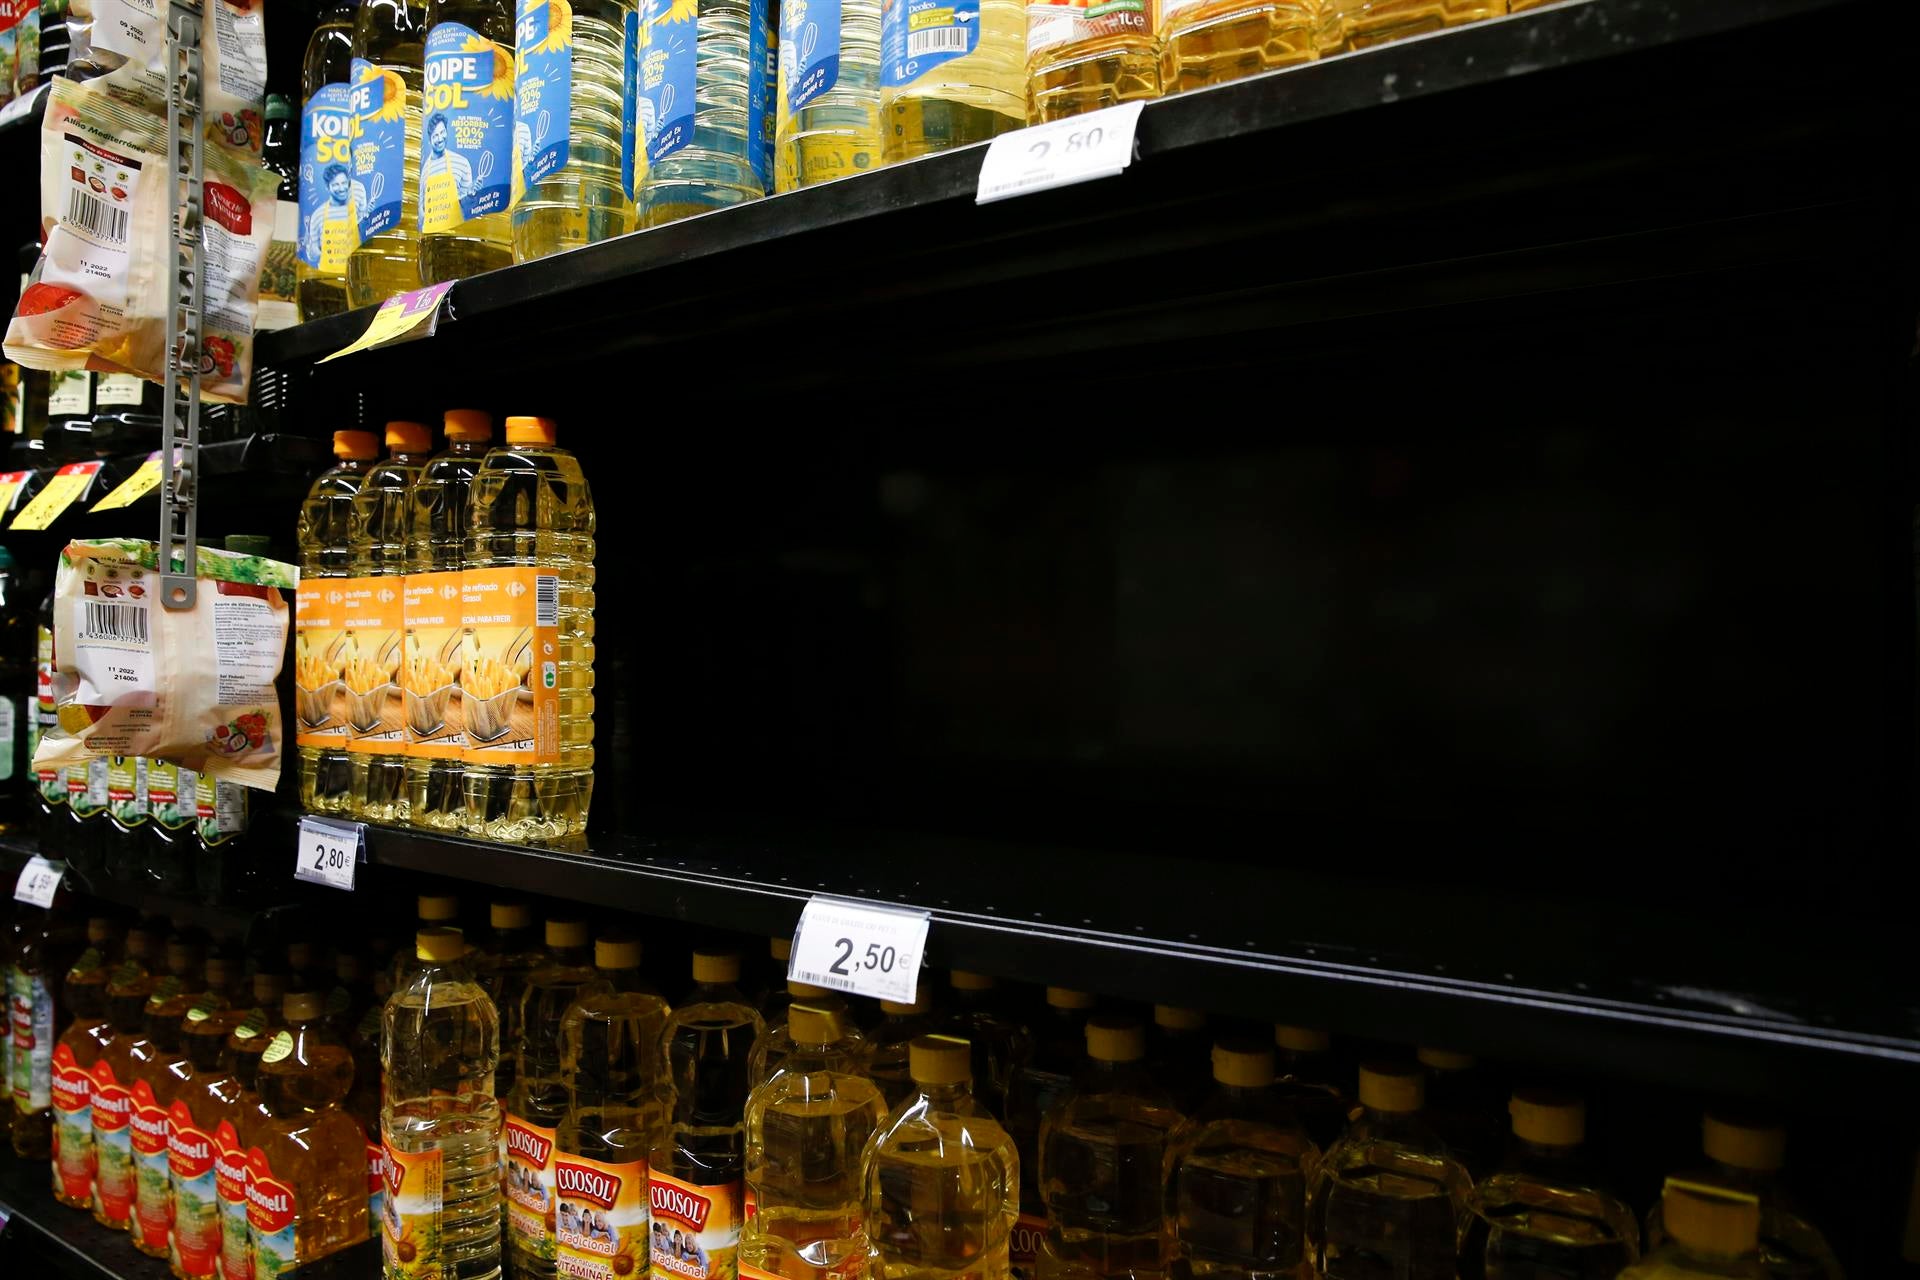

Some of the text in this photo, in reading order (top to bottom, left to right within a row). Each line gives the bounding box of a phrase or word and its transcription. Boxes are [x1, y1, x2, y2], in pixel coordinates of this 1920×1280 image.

[425, 82, 468, 115] SOL
[452, 120, 488, 129] ABSORBEN
[455, 127, 484, 139] 20%
[88, 126, 146, 154] Mediterráneo
[85, 268, 111, 279] 214005
[90, 263, 108, 272] 2022
[89, 632, 117, 641] 436006
[114, 674, 139, 682] 214005
[119, 667, 135, 675] 2022
[91, 1093, 130, 1112] rbonell
[130, 1112, 168, 1135] rbonell
[168, 1134, 208, 1159] rbonell
[558, 1168, 612, 1203] COOSOL
[245, 1183, 288, 1212] rbonell
[651, 1186, 702, 1225] COOSOL
[560, 1229, 615, 1254] Tradicional
[653, 1249, 705, 1279] Tradicional
